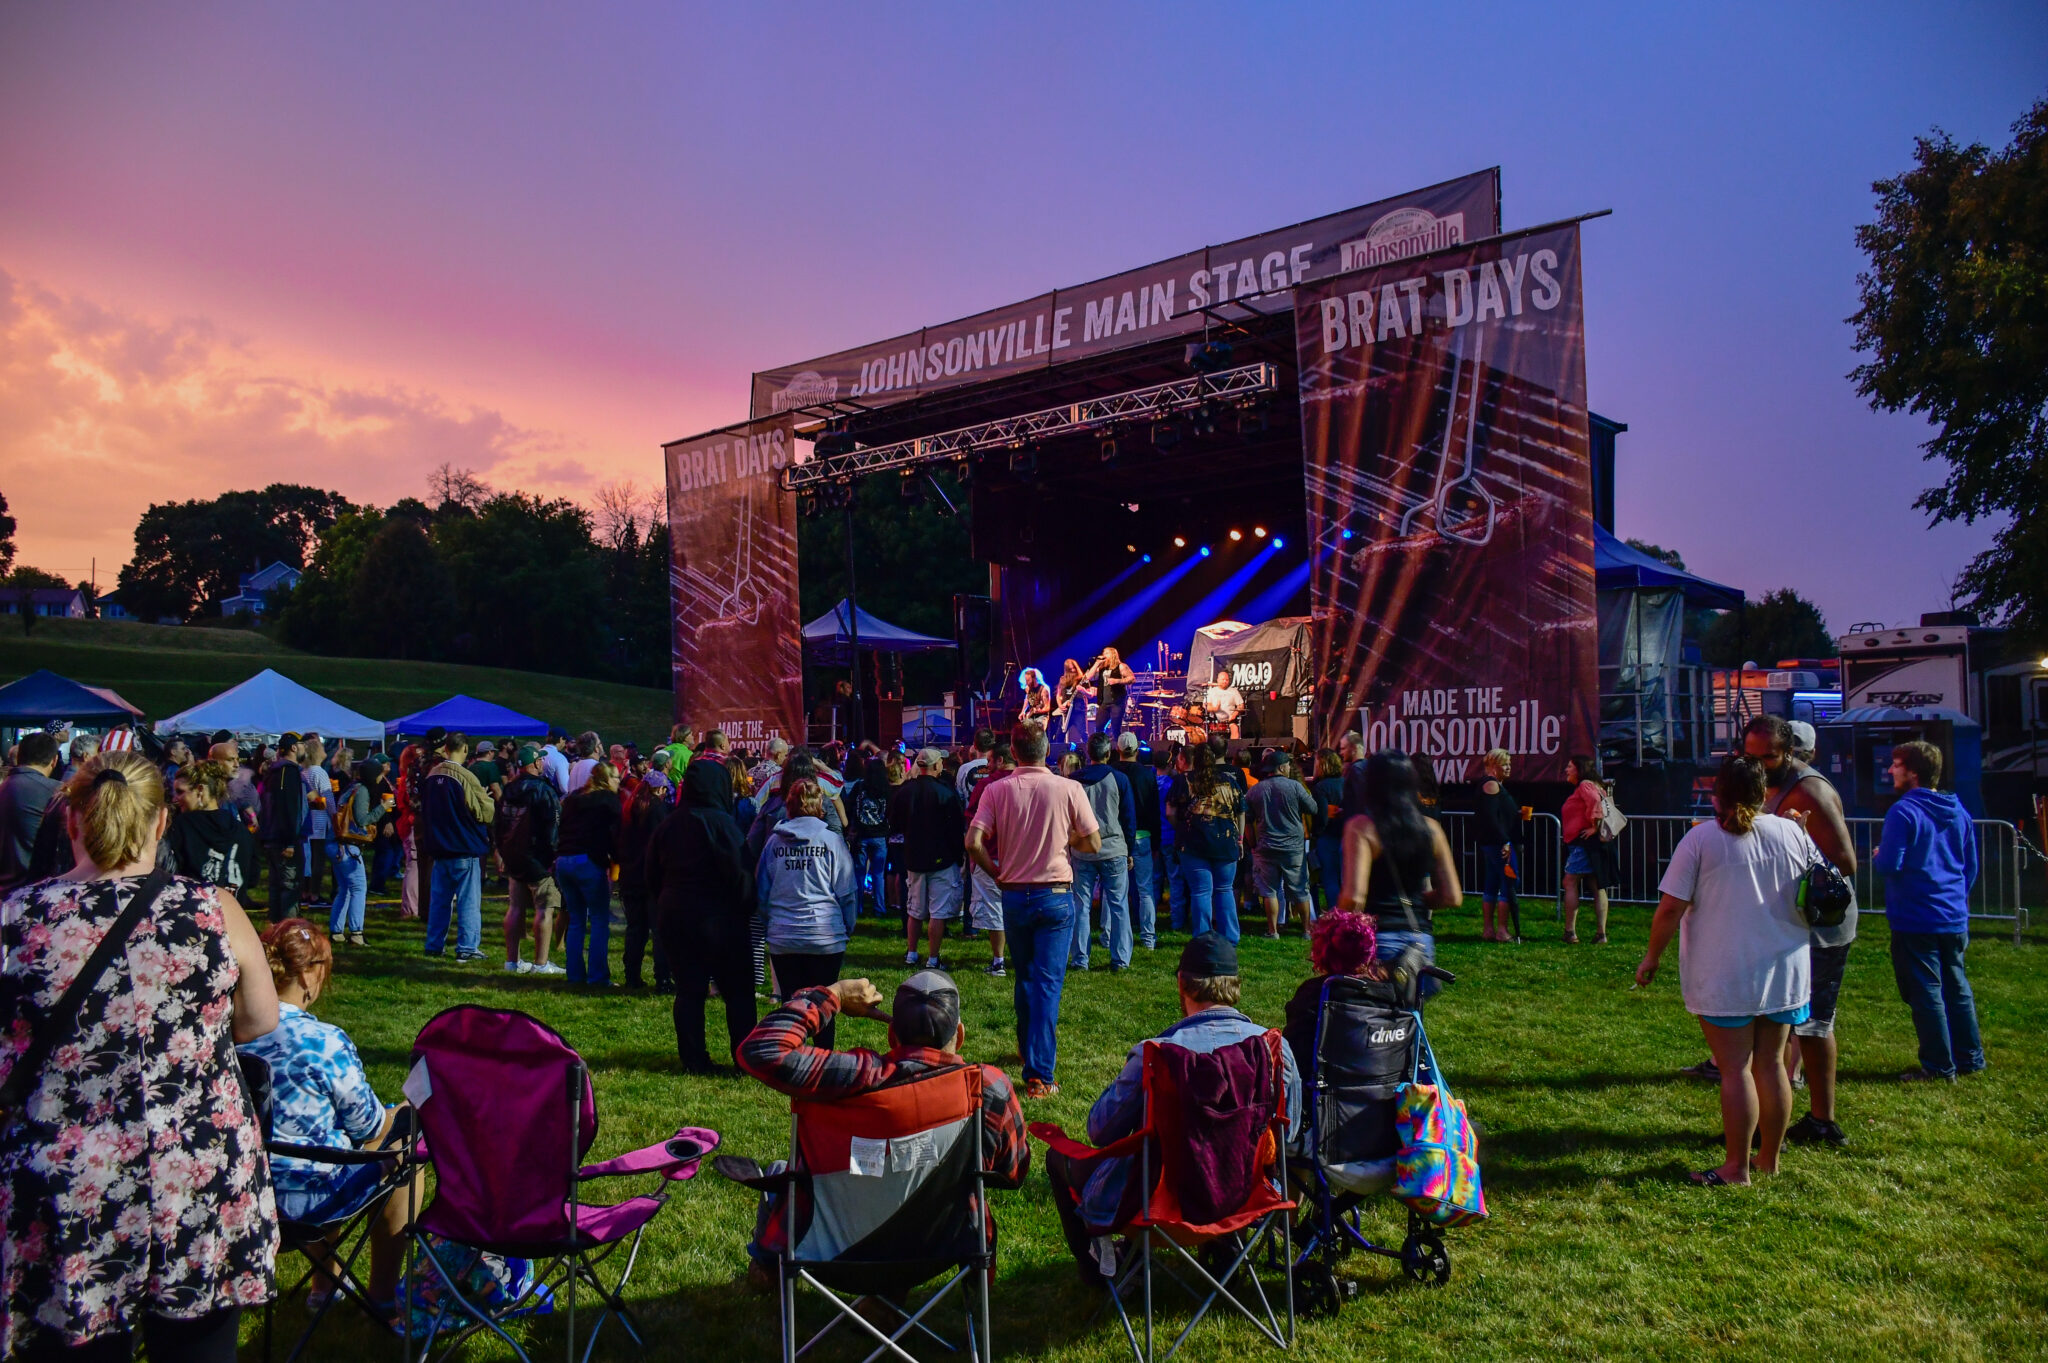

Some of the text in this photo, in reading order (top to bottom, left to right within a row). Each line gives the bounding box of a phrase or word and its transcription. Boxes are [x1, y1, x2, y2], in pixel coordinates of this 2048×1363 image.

[1345, 220, 1460, 271] Johnsonville
[1320, 248, 1561, 354] BRAT DAYS
[851, 243, 1313, 397] JOHNSONVILLE MAIN STAGE
[678, 428, 786, 492] BRAT DAYS
[1231, 661, 1273, 687] MOJO
[1403, 687, 1504, 716] MADE THE
[745, 720, 762, 738] THE
[1358, 699, 1561, 757] Johnsonville
[773, 845, 828, 859] VOLUNTEER
[785, 859, 812, 871] STAFF
[1370, 1026, 1406, 1043] drive
